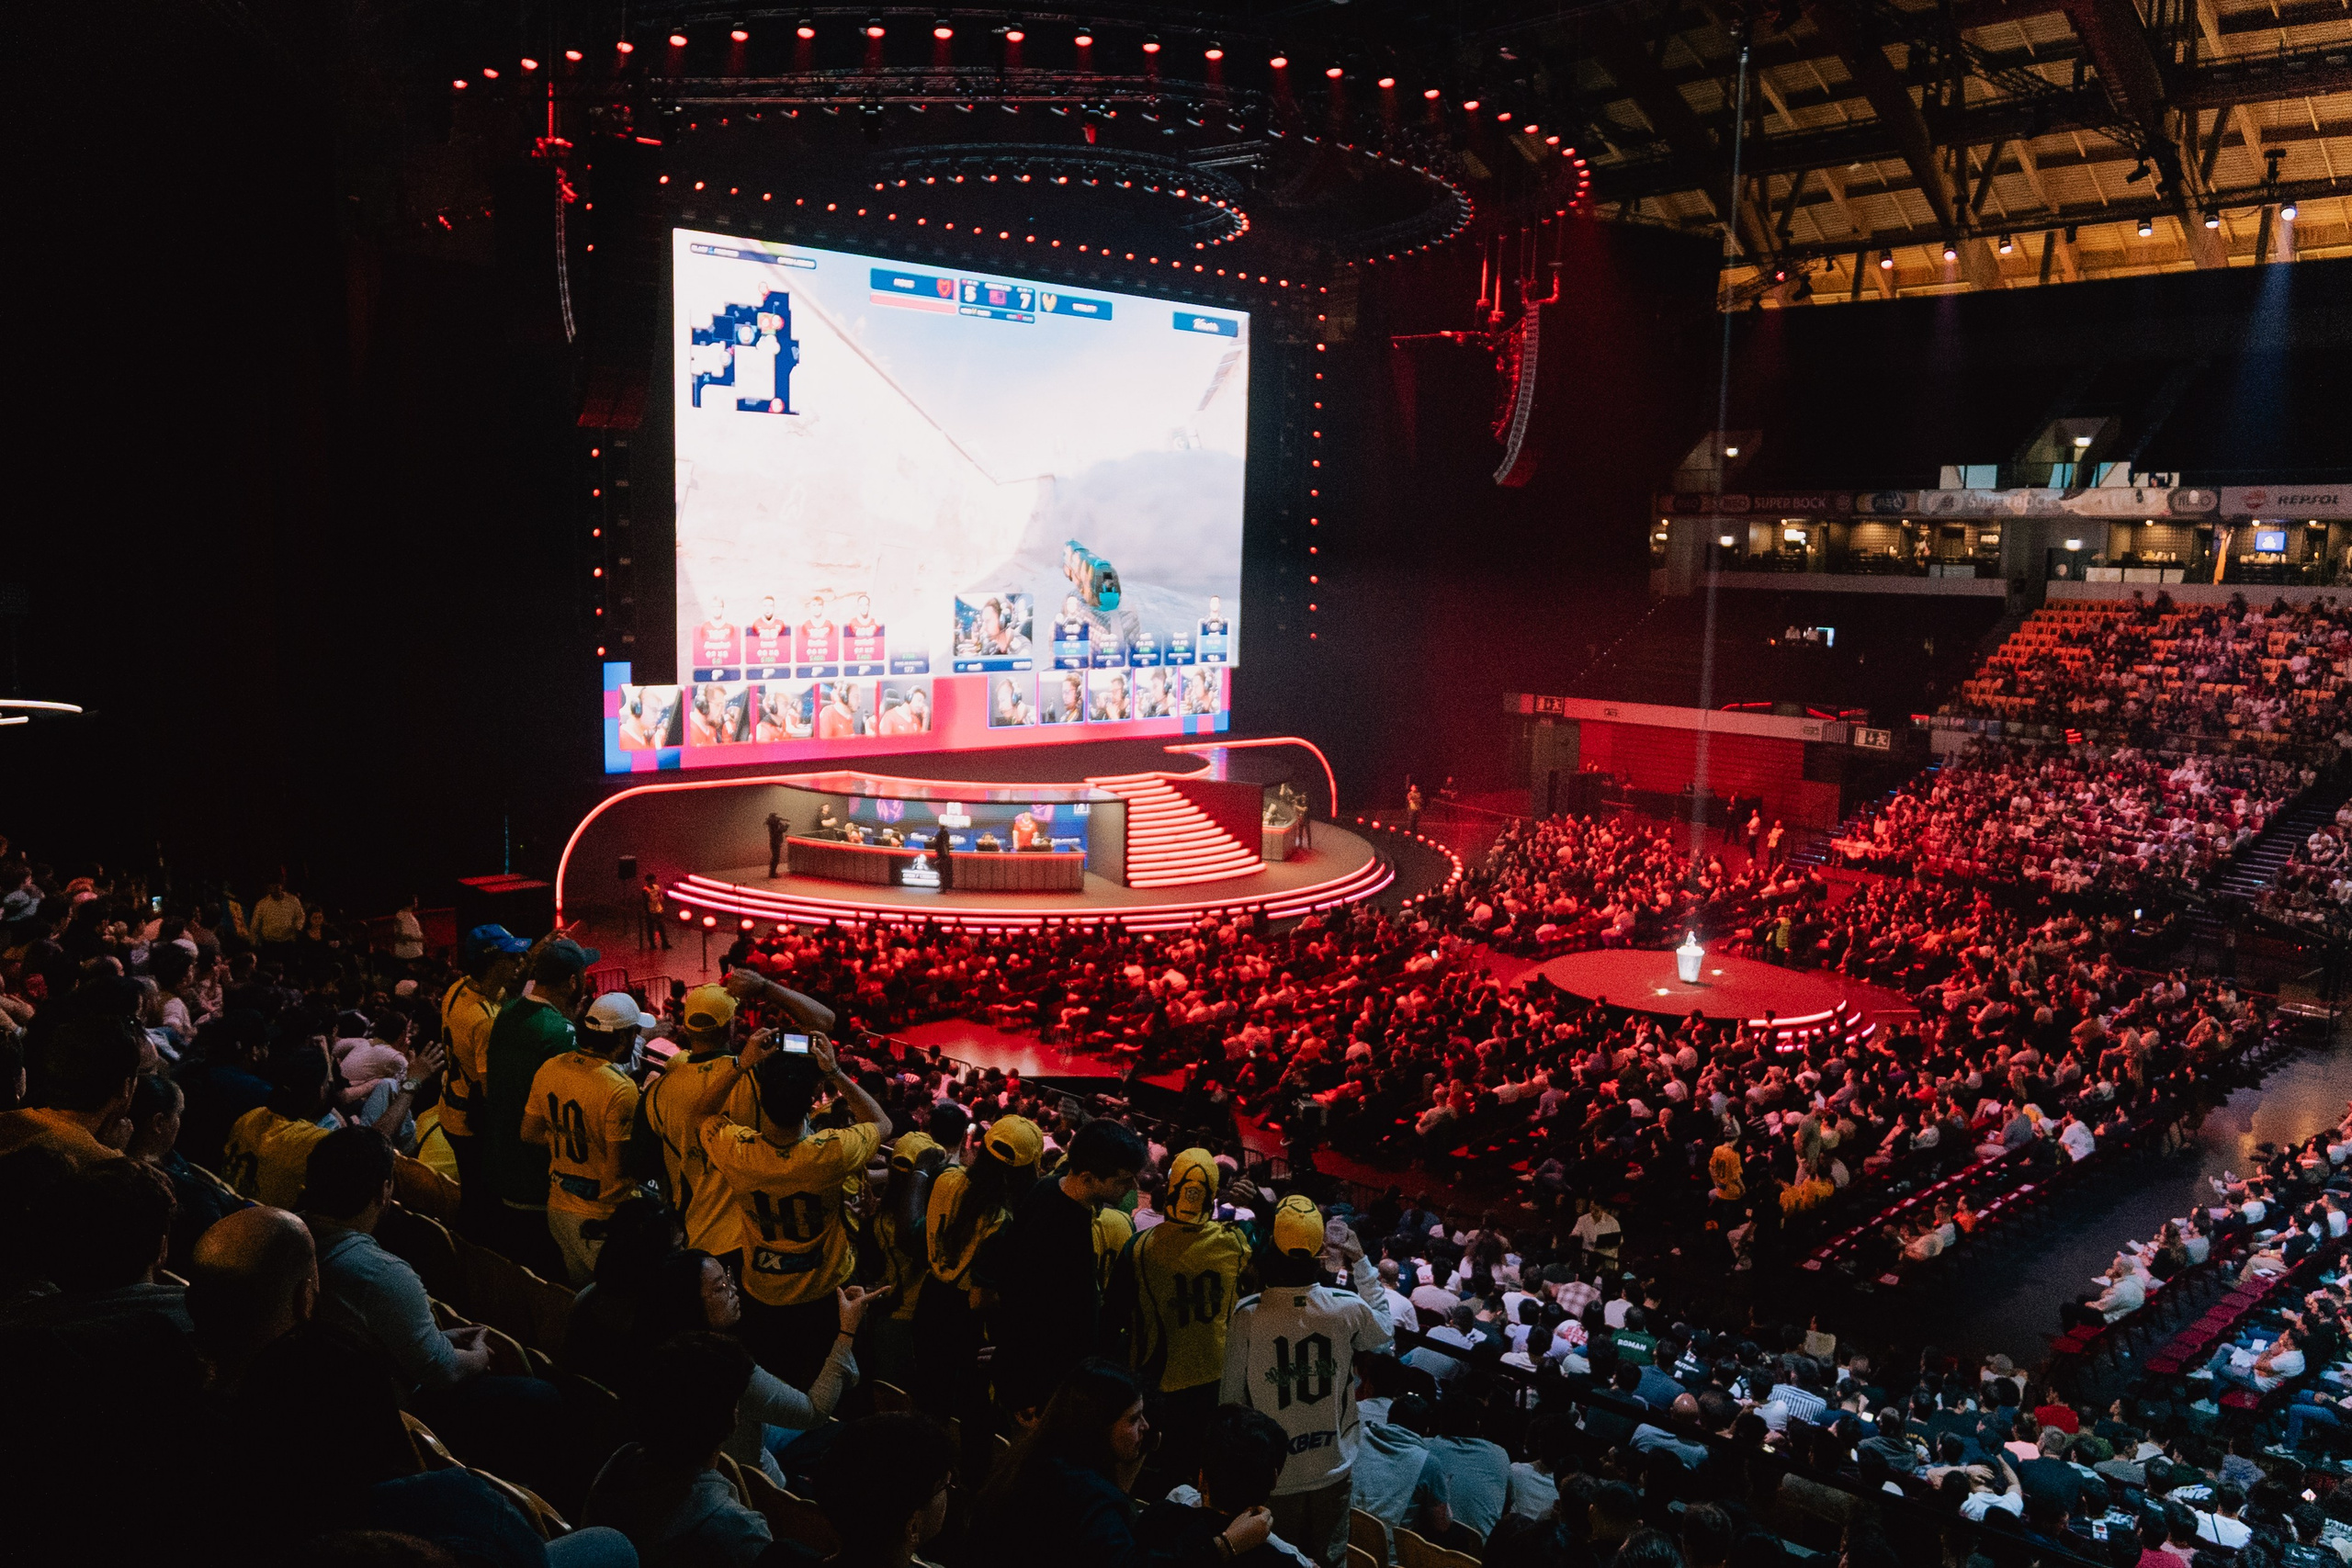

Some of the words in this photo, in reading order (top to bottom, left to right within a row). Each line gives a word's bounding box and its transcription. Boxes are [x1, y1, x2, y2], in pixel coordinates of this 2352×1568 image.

[965, 285, 977, 302] 5
[1020, 293, 1032, 310] 7
[1754, 497, 1791, 509] SUPER
[1792, 497, 1827, 509] BOCK
[2278, 494, 2339, 505] REPSOL
[547, 1091, 588, 1164] 10
[750, 1190, 823, 1242] 10
[1170, 1269, 1224, 1327] 10
[1617, 1338, 1647, 1352] ROMAN
[1272, 1331, 1333, 1410] 10
